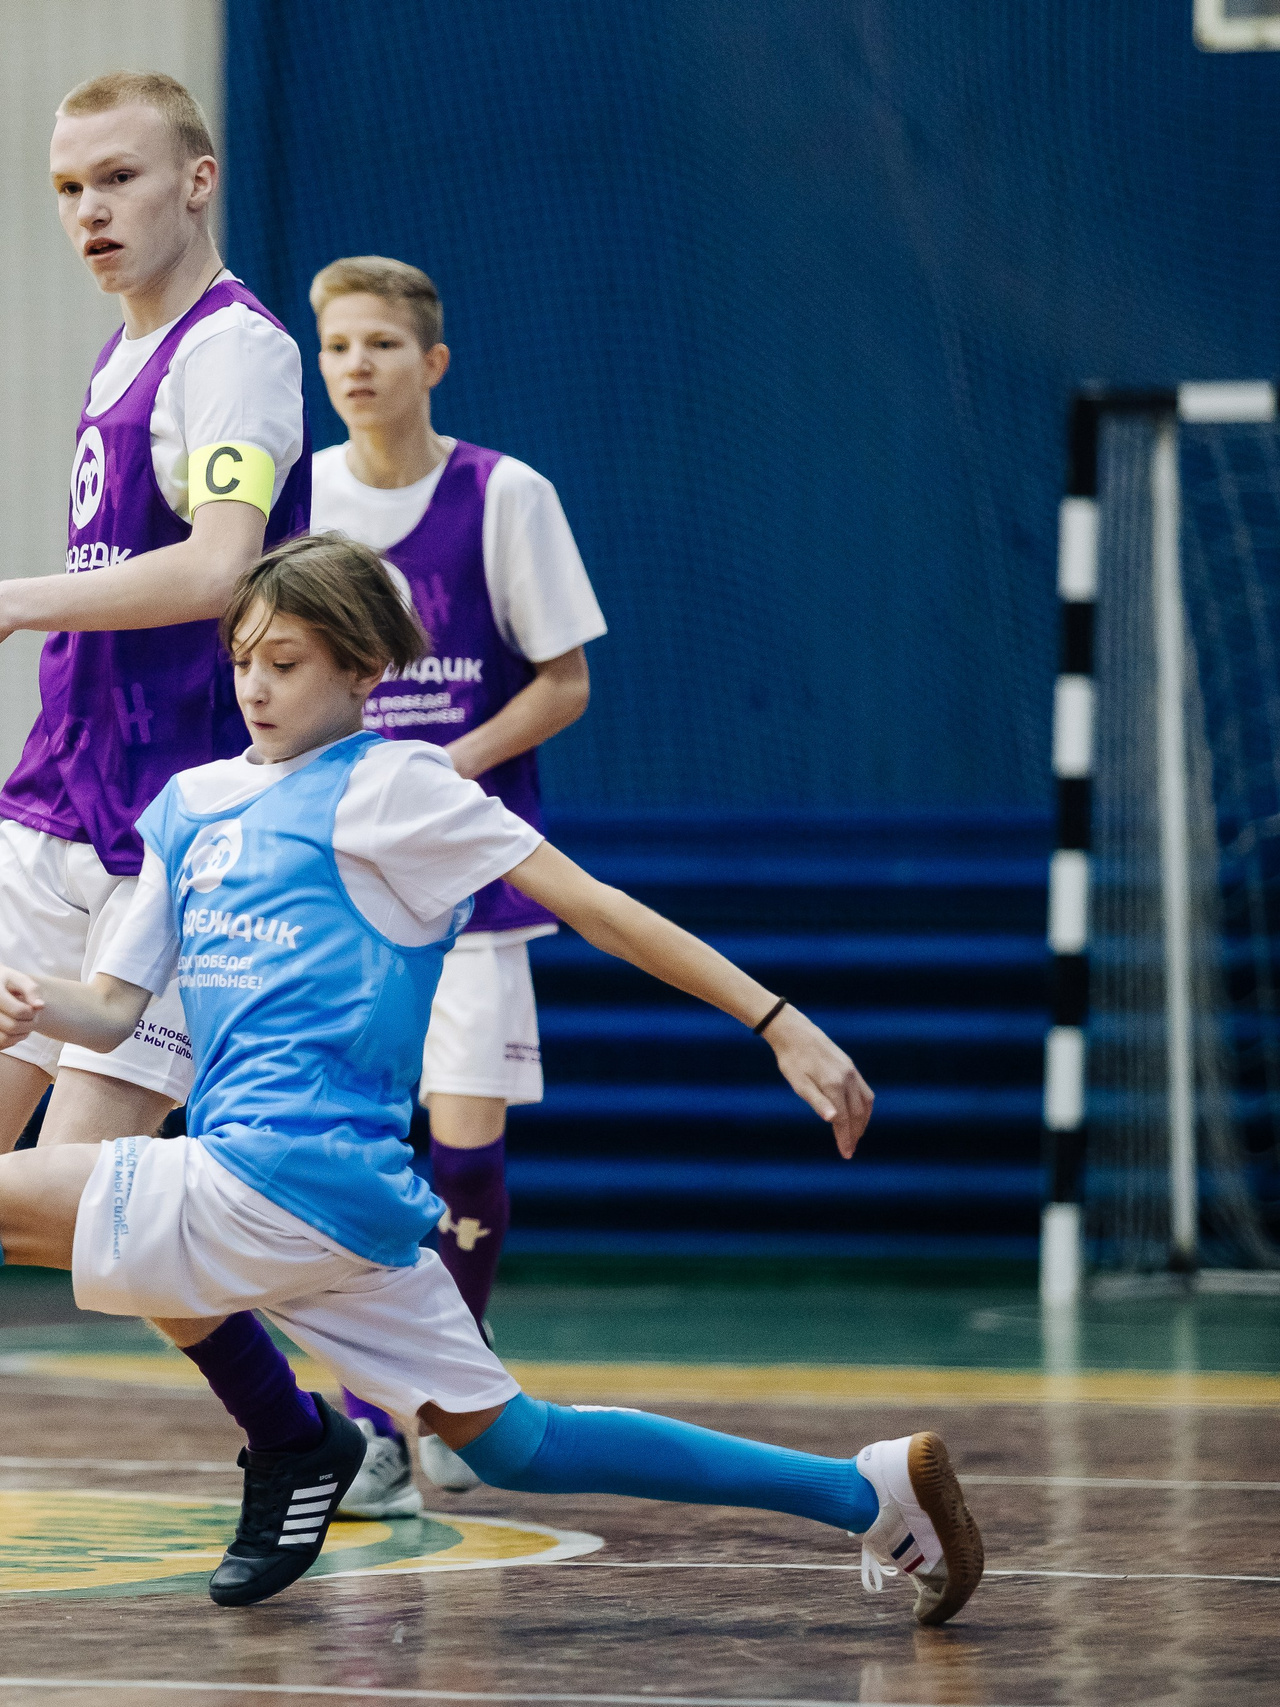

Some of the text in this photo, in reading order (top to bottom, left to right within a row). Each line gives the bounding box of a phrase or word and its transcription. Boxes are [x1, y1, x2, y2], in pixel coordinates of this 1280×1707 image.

[205, 446, 243, 495] C
[183, 908, 303, 949] ДЕЖДИК
[144, 1034, 165, 1048] МЫ
[168, 1043, 193, 1060] СИЛЬ
